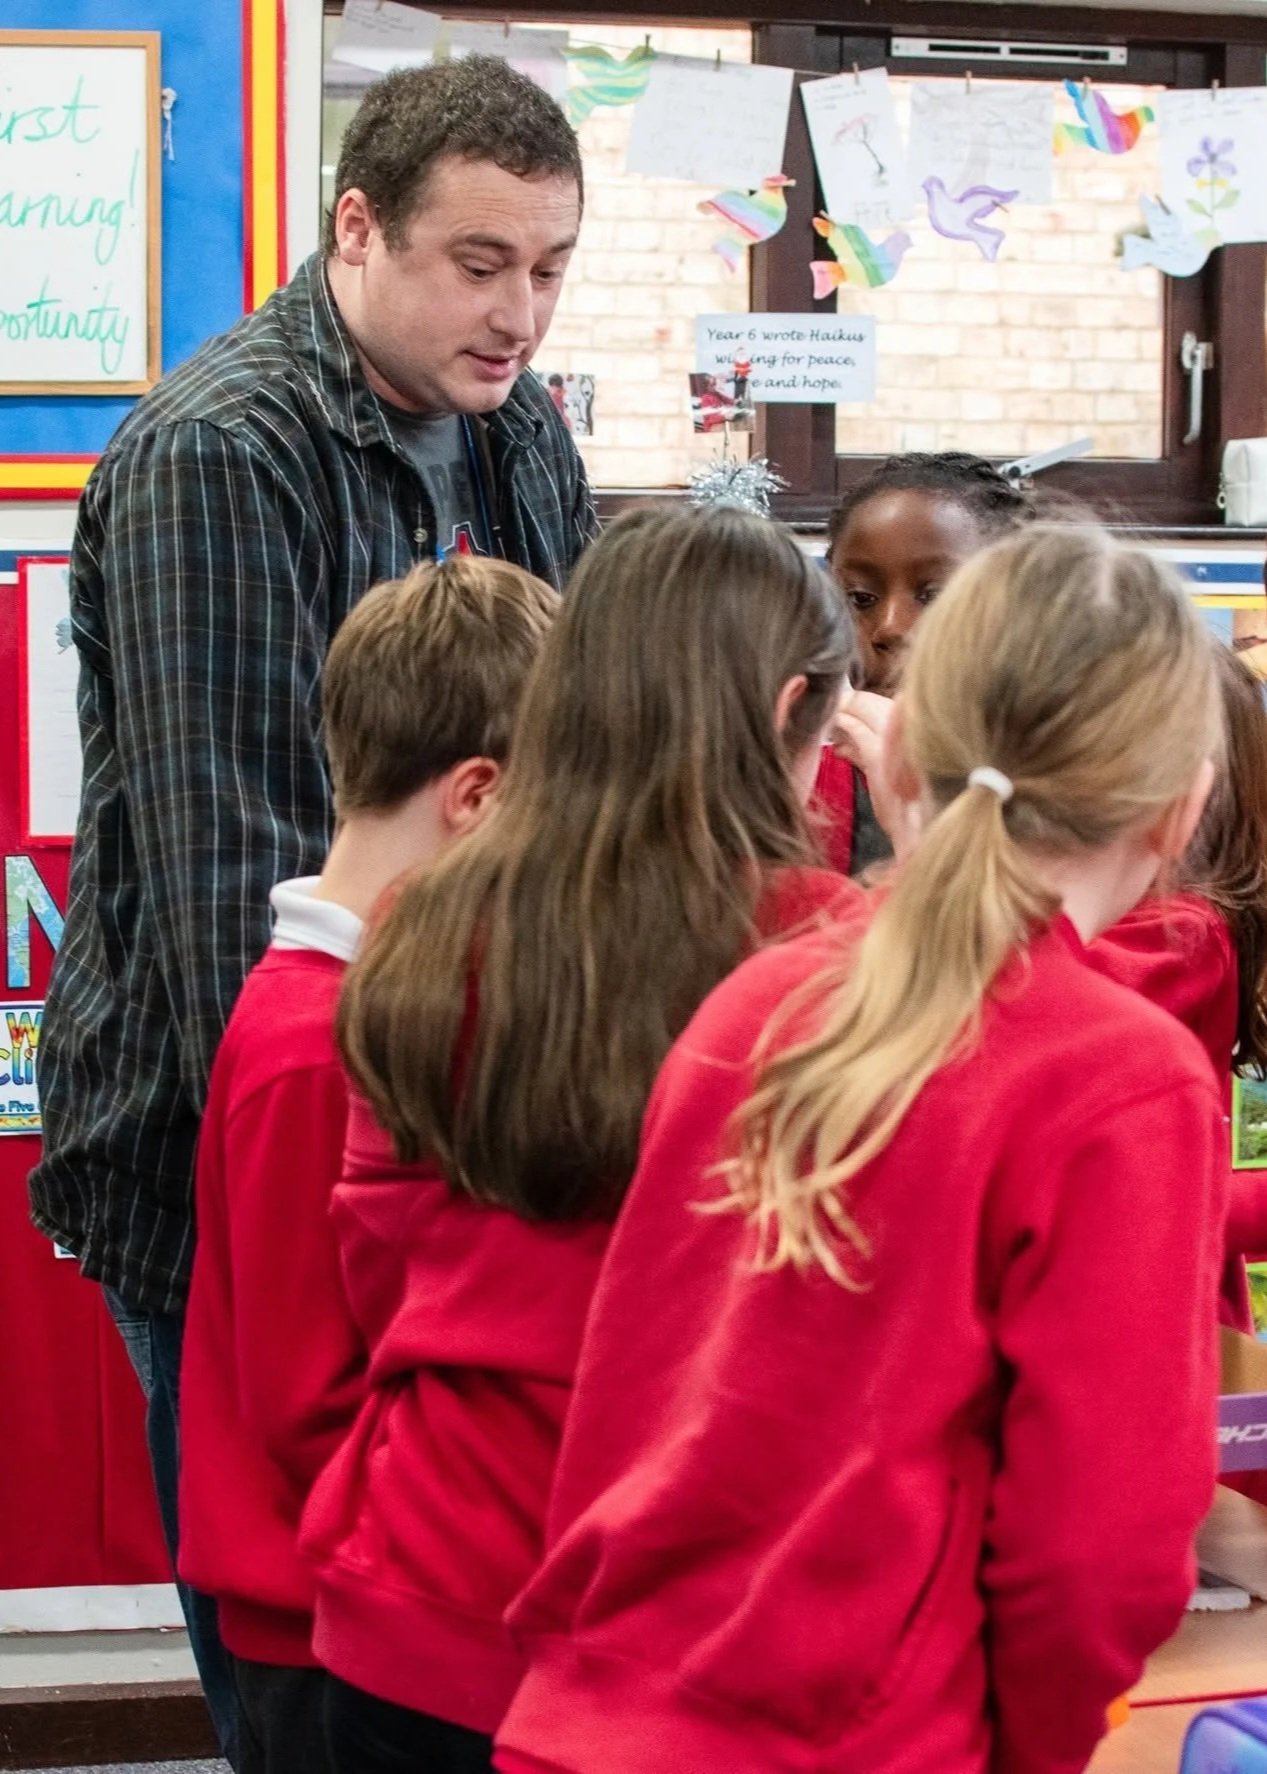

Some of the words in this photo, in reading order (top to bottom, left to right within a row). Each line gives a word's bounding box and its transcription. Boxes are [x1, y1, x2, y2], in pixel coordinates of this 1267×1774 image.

[707, 328, 744, 341] Year
[748, 328, 757, 341] 6
[763, 330, 805, 341] wrote
[809, 328, 866, 343] Haikus
[715, 353, 777, 369] wiing
[781, 350, 804, 368] for
[764, 375, 797, 388] and
